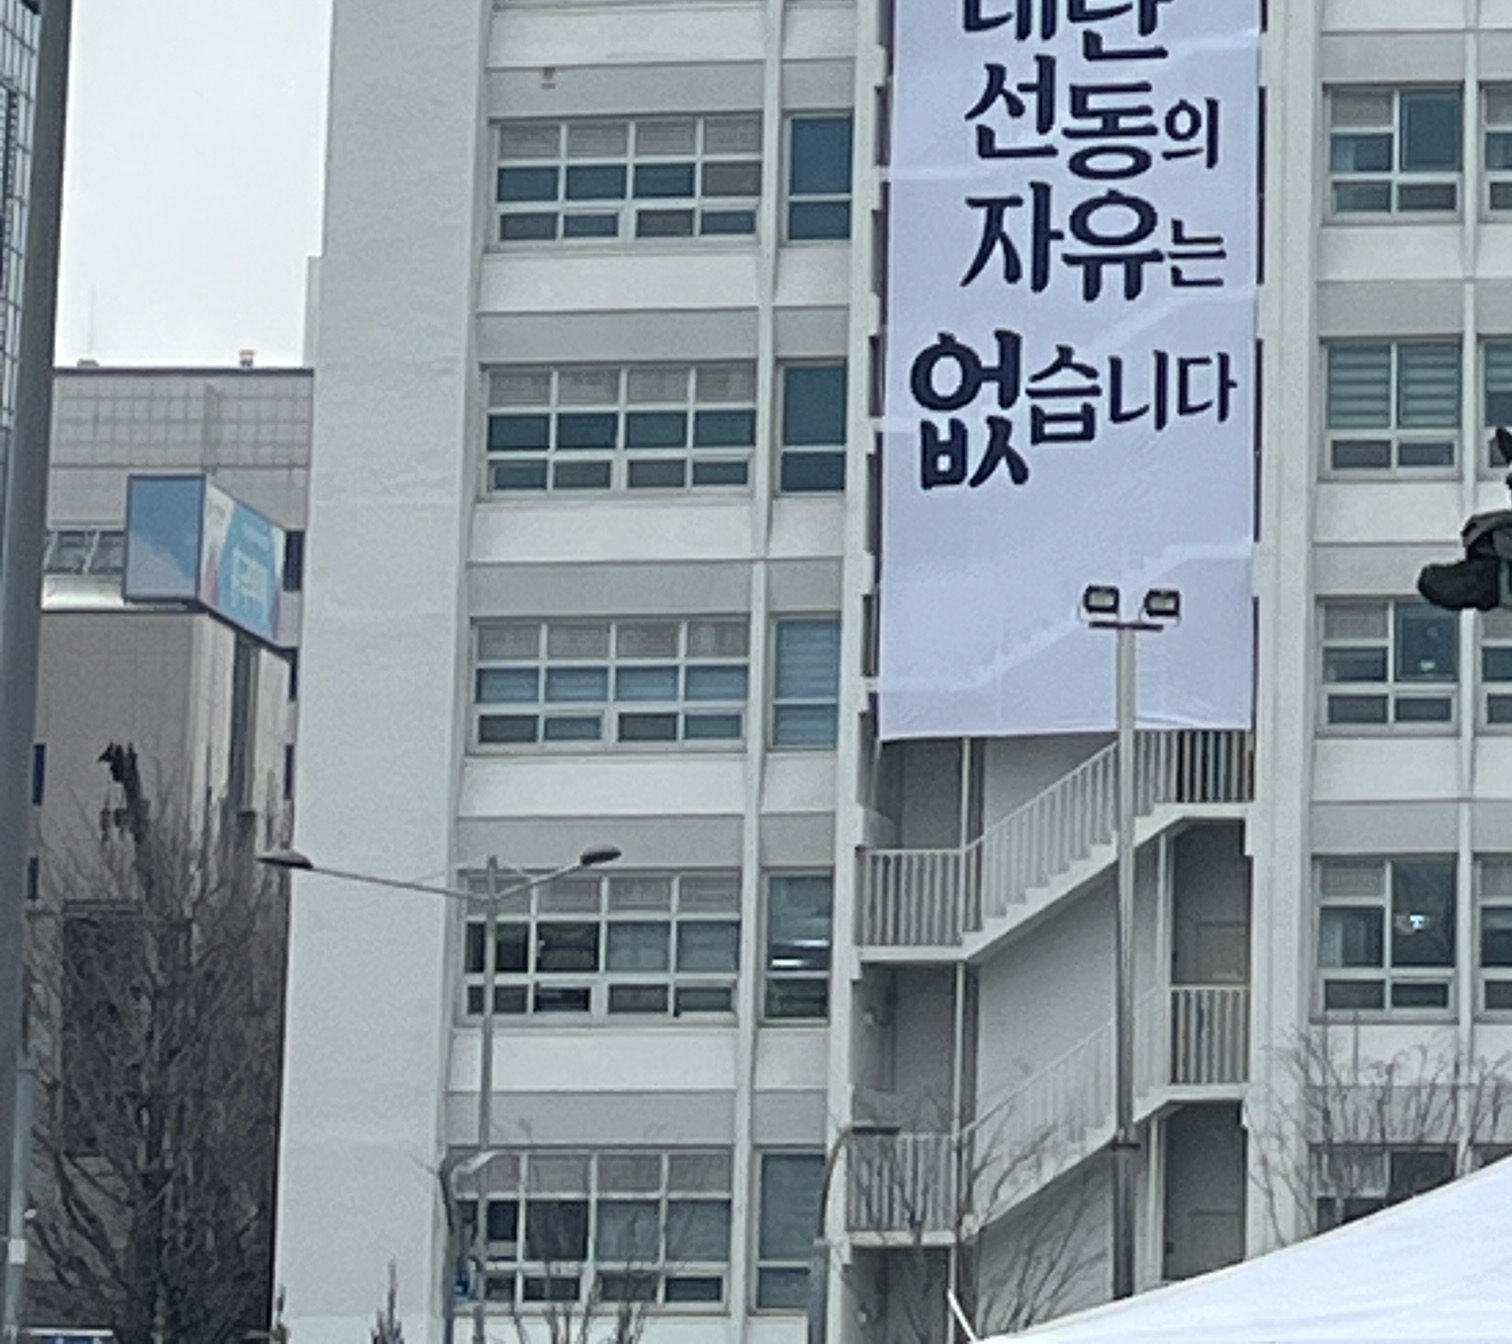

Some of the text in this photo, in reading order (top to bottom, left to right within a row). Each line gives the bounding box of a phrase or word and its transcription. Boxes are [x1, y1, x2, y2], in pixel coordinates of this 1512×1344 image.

[964, 54, 1220, 181] 선동의
[960, 181, 1227, 302] 자유는
[910, 330, 1238, 490] 없습니다
